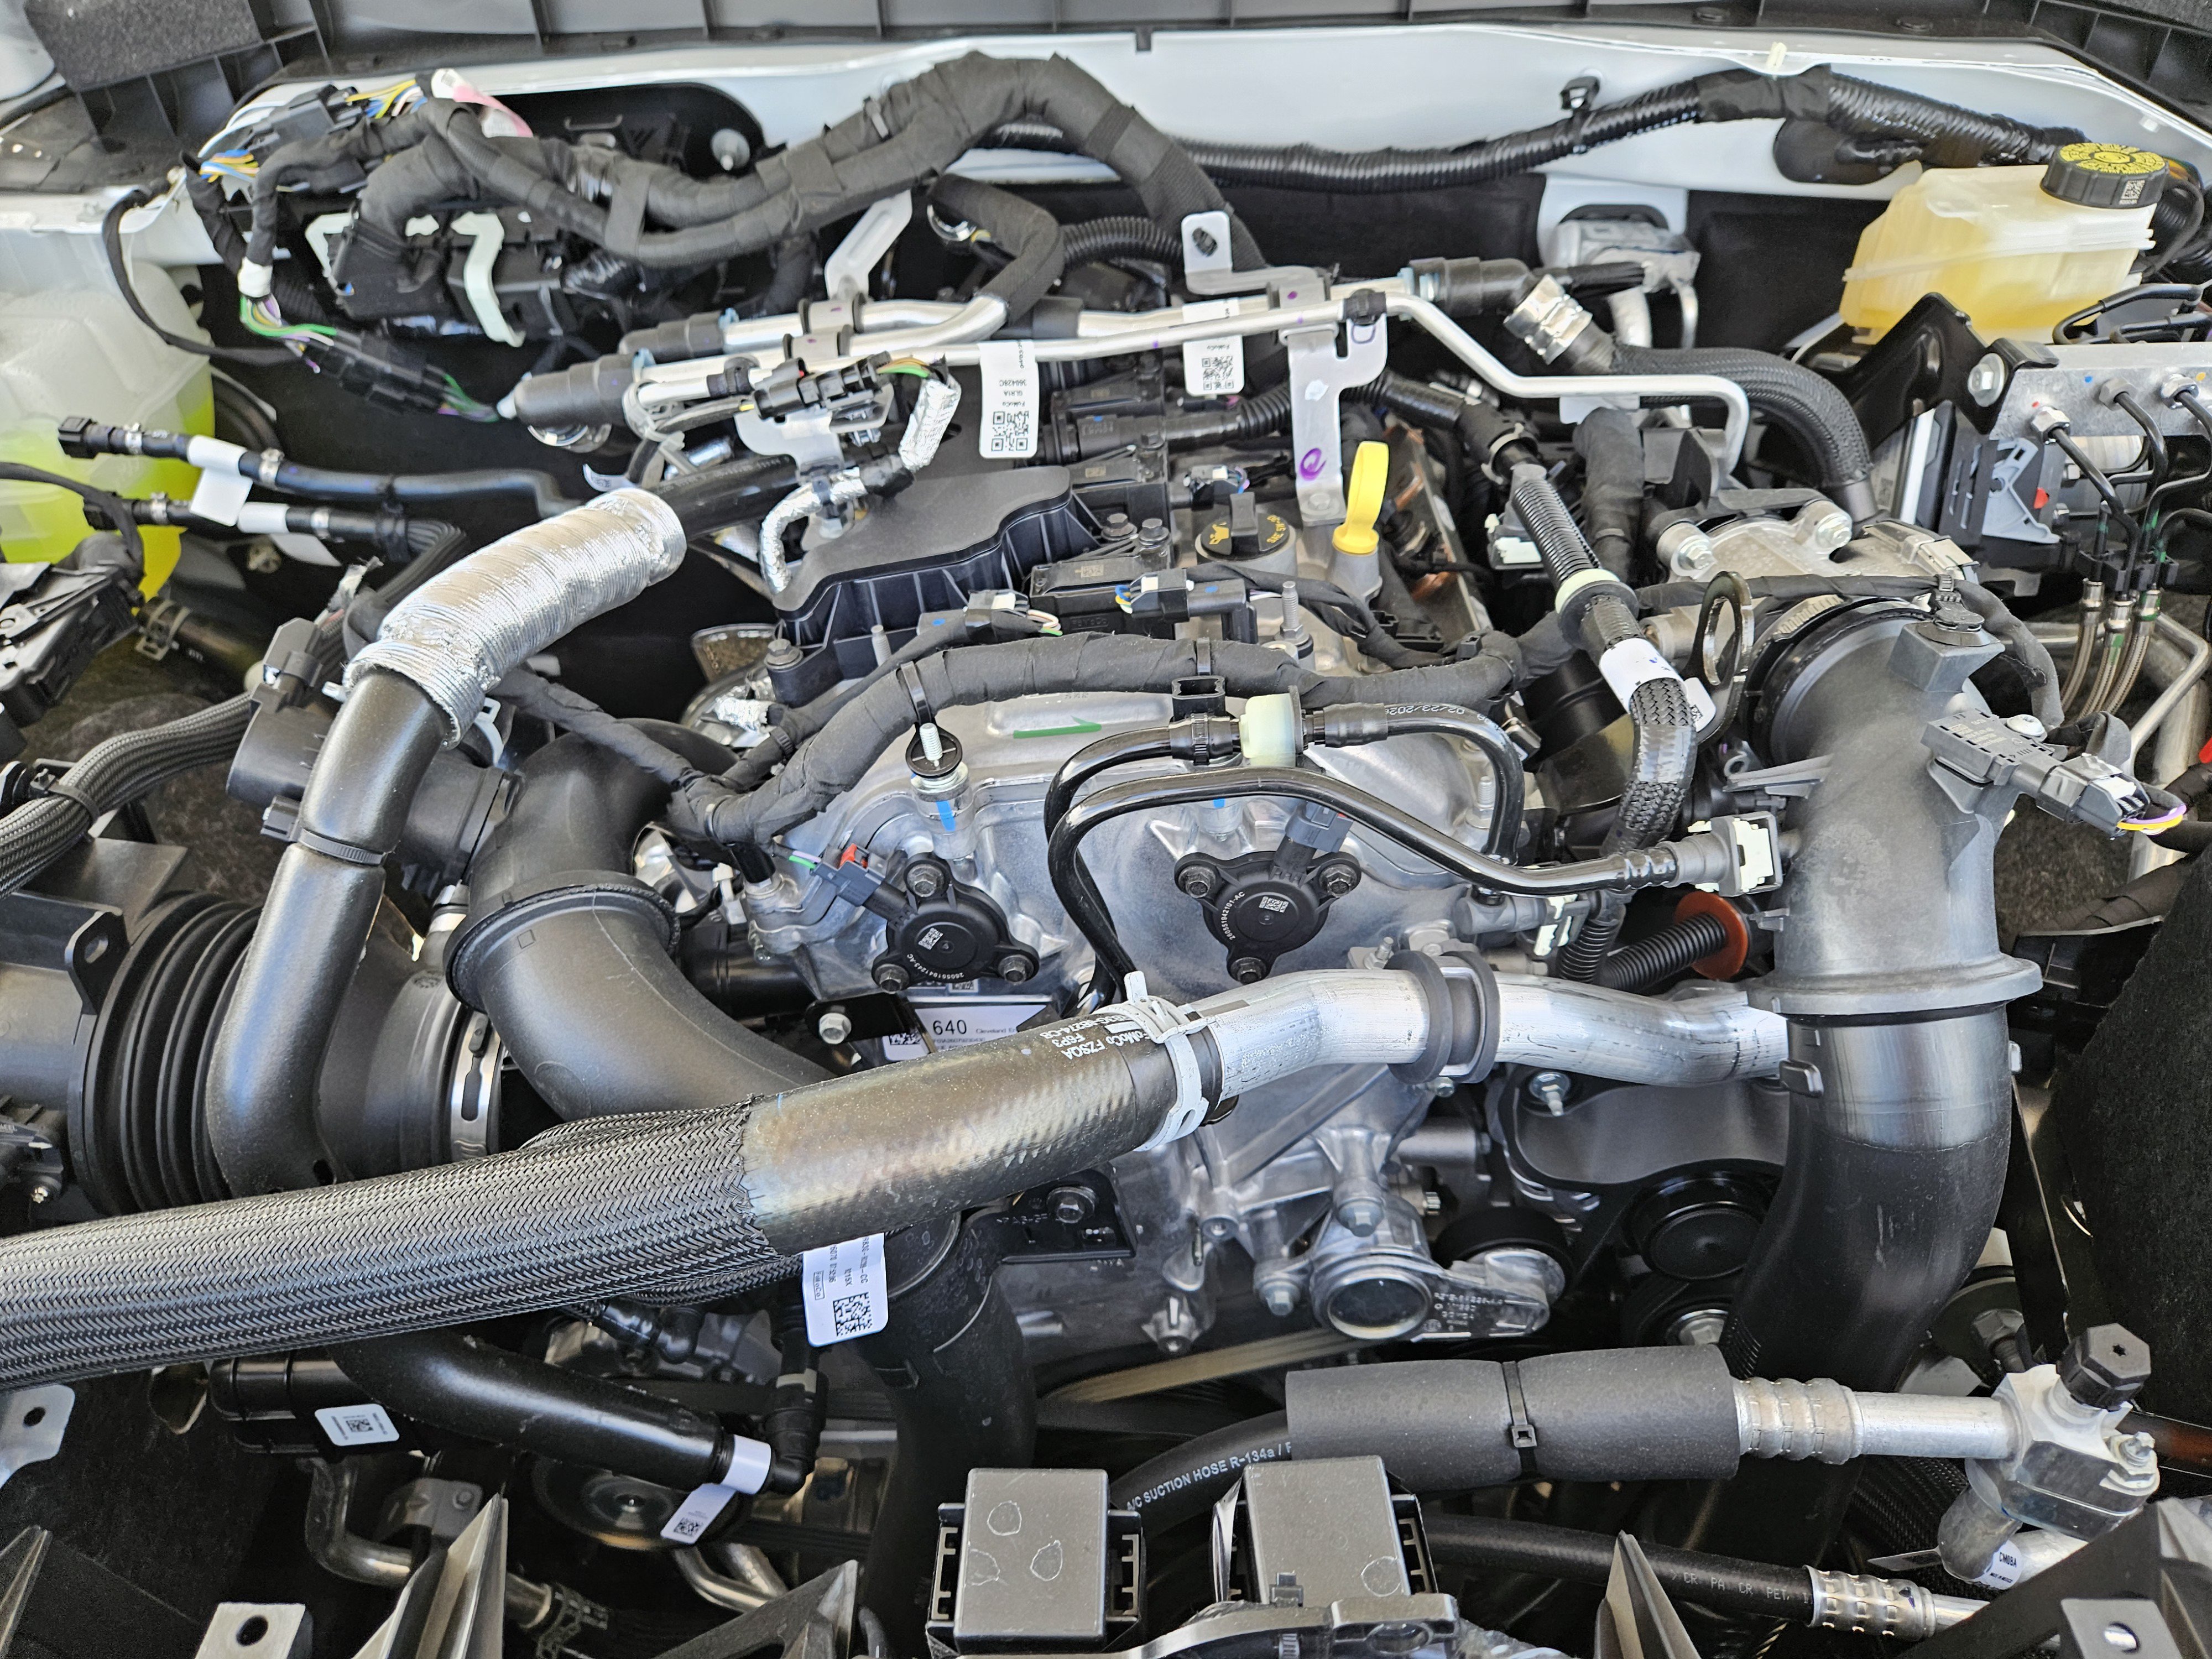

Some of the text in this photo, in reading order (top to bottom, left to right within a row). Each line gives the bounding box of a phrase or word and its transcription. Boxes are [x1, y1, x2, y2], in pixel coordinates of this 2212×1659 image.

[1266, 533, 1285, 544] SAE
[932, 1019, 967, 1035] 640
[1051, 1032, 1086, 1048] F6P3
[1060, 1039, 1105, 1060] FZSQA
[1126, 1495, 1143, 1512] A/C
[1142, 1473, 1192, 1504] SUCTION
[1192, 1459, 1229, 1482] HOSE
[1229, 1447, 1275, 1469] R-134a
[1683, 1572, 1699, 1585] CR
[1710, 1577, 1726, 1592] PA
[1738, 1582, 1754, 1595] CR
